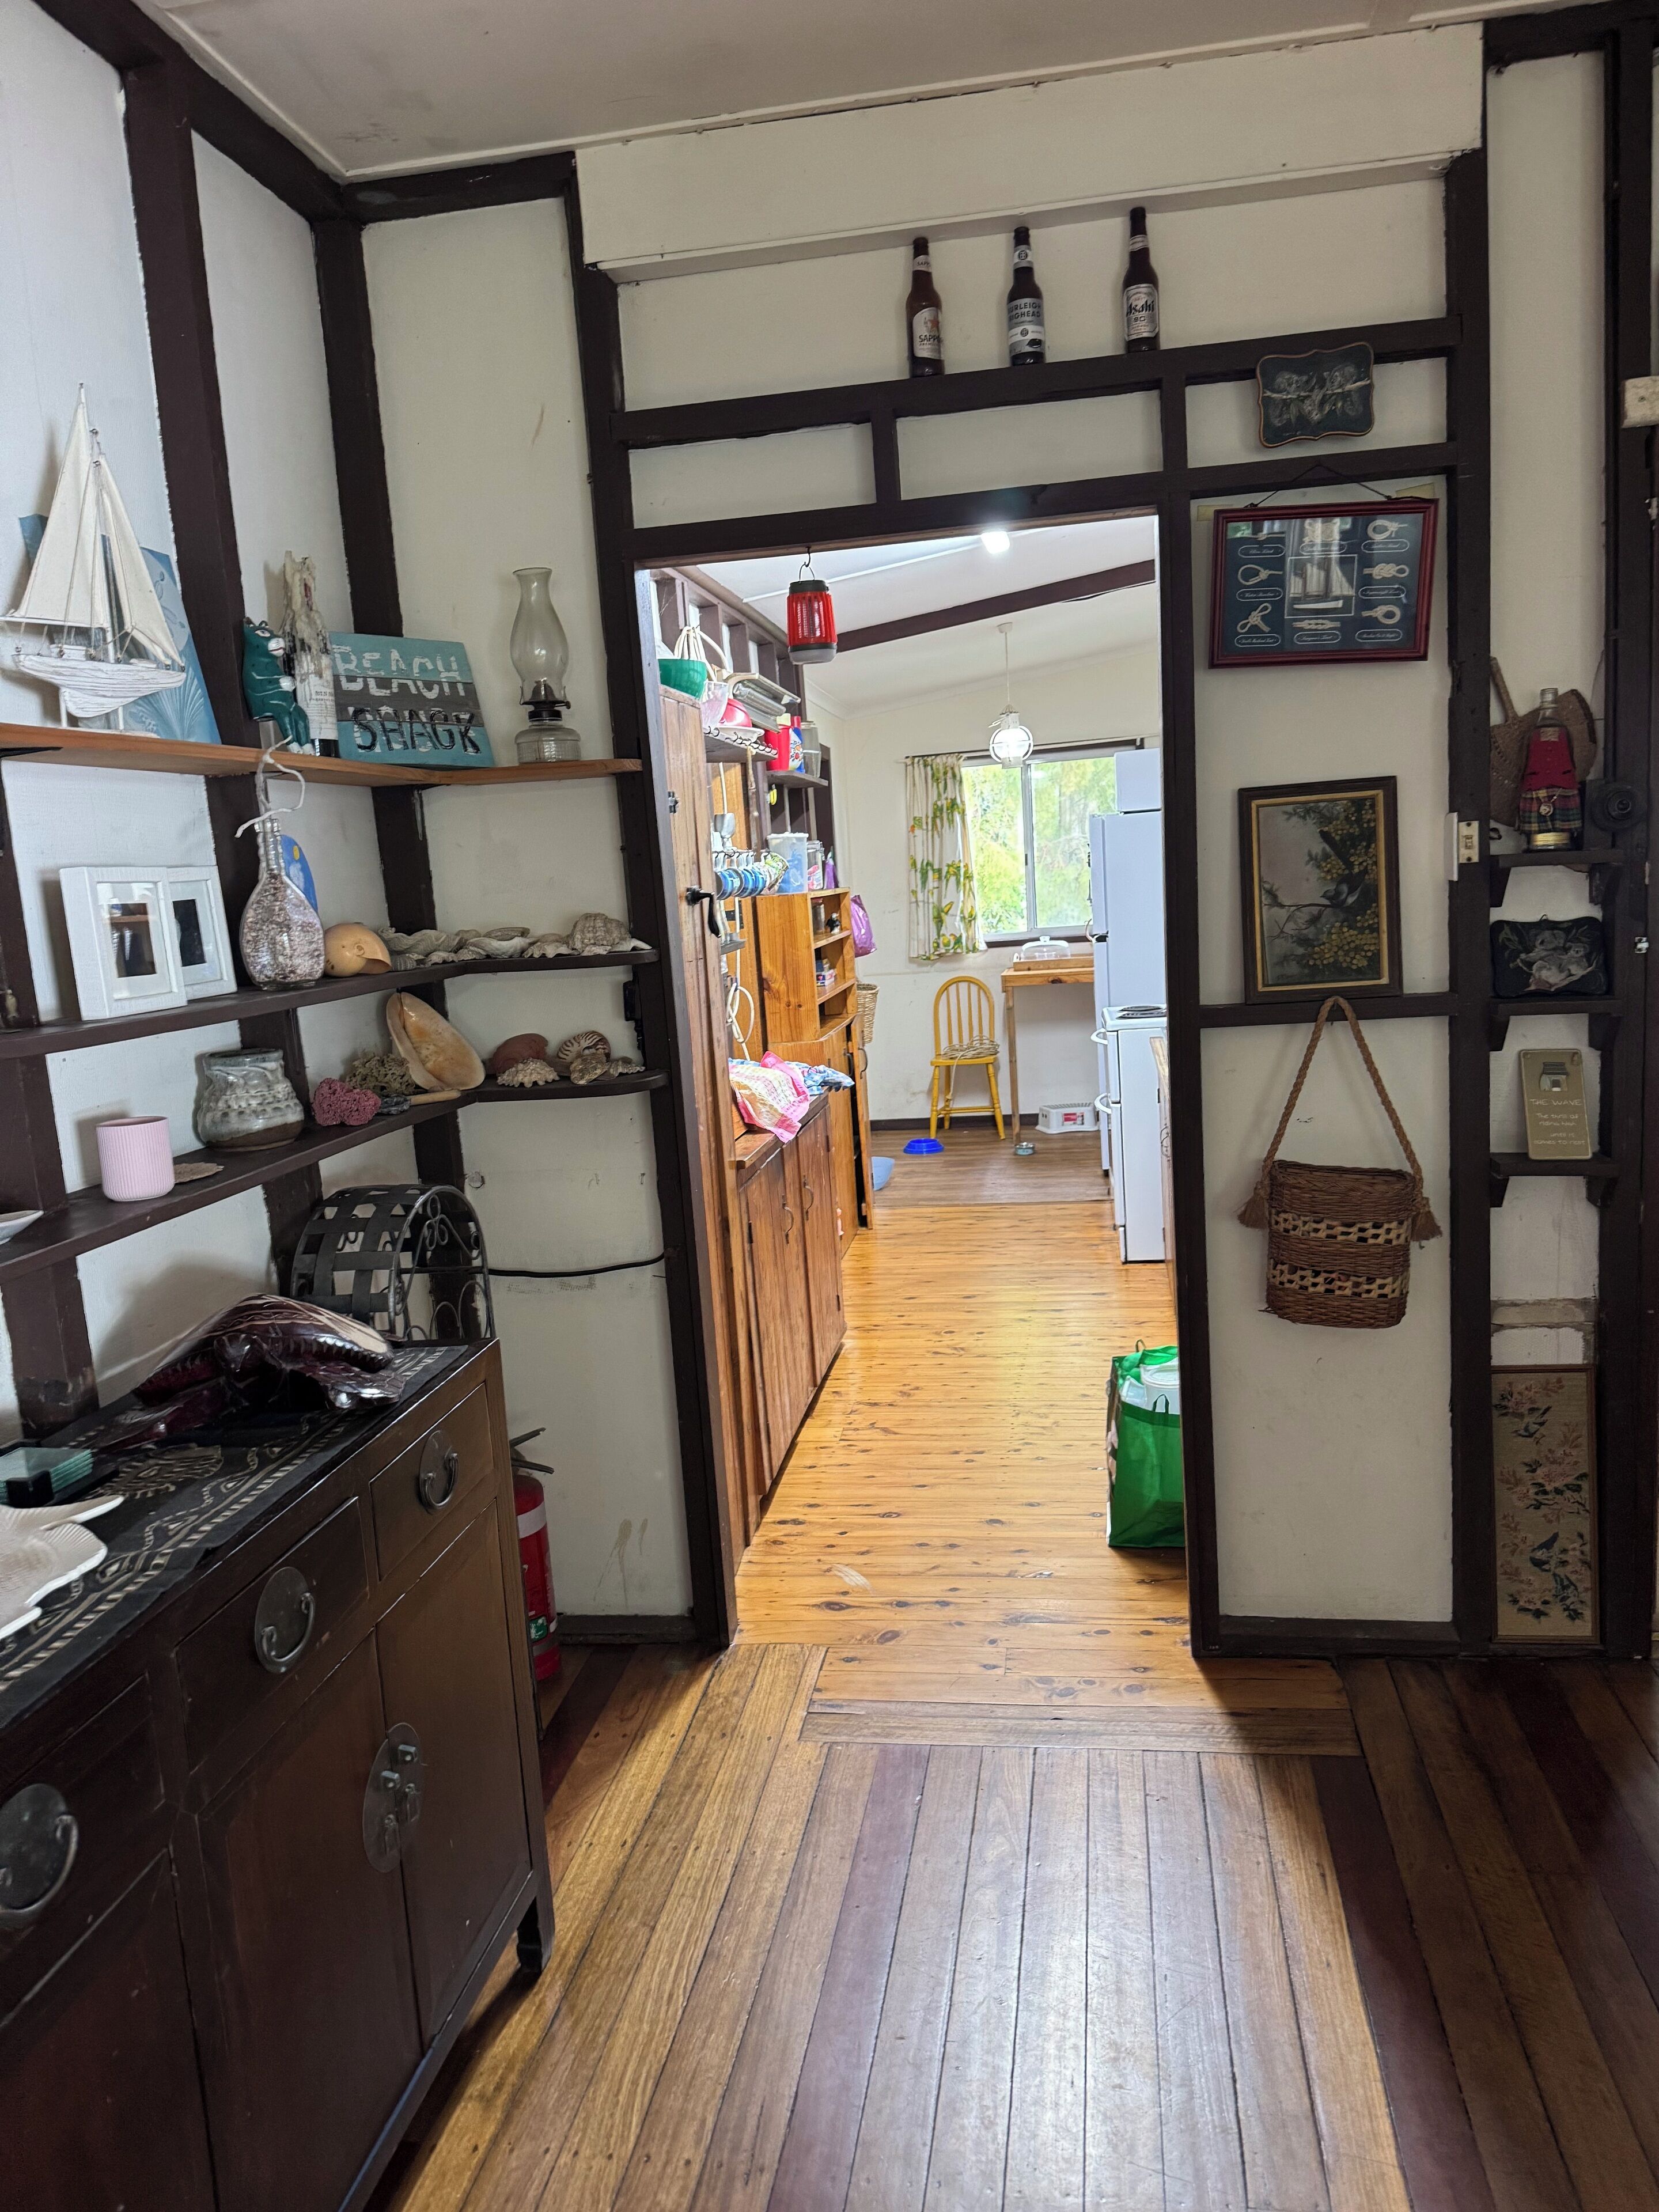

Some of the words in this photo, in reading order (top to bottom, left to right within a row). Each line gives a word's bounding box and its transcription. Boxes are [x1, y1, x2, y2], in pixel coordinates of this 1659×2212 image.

[1126, 300, 1154, 317] Asahi
[332, 645, 465, 699] BEACH
[351, 707, 482, 754] SHACK
